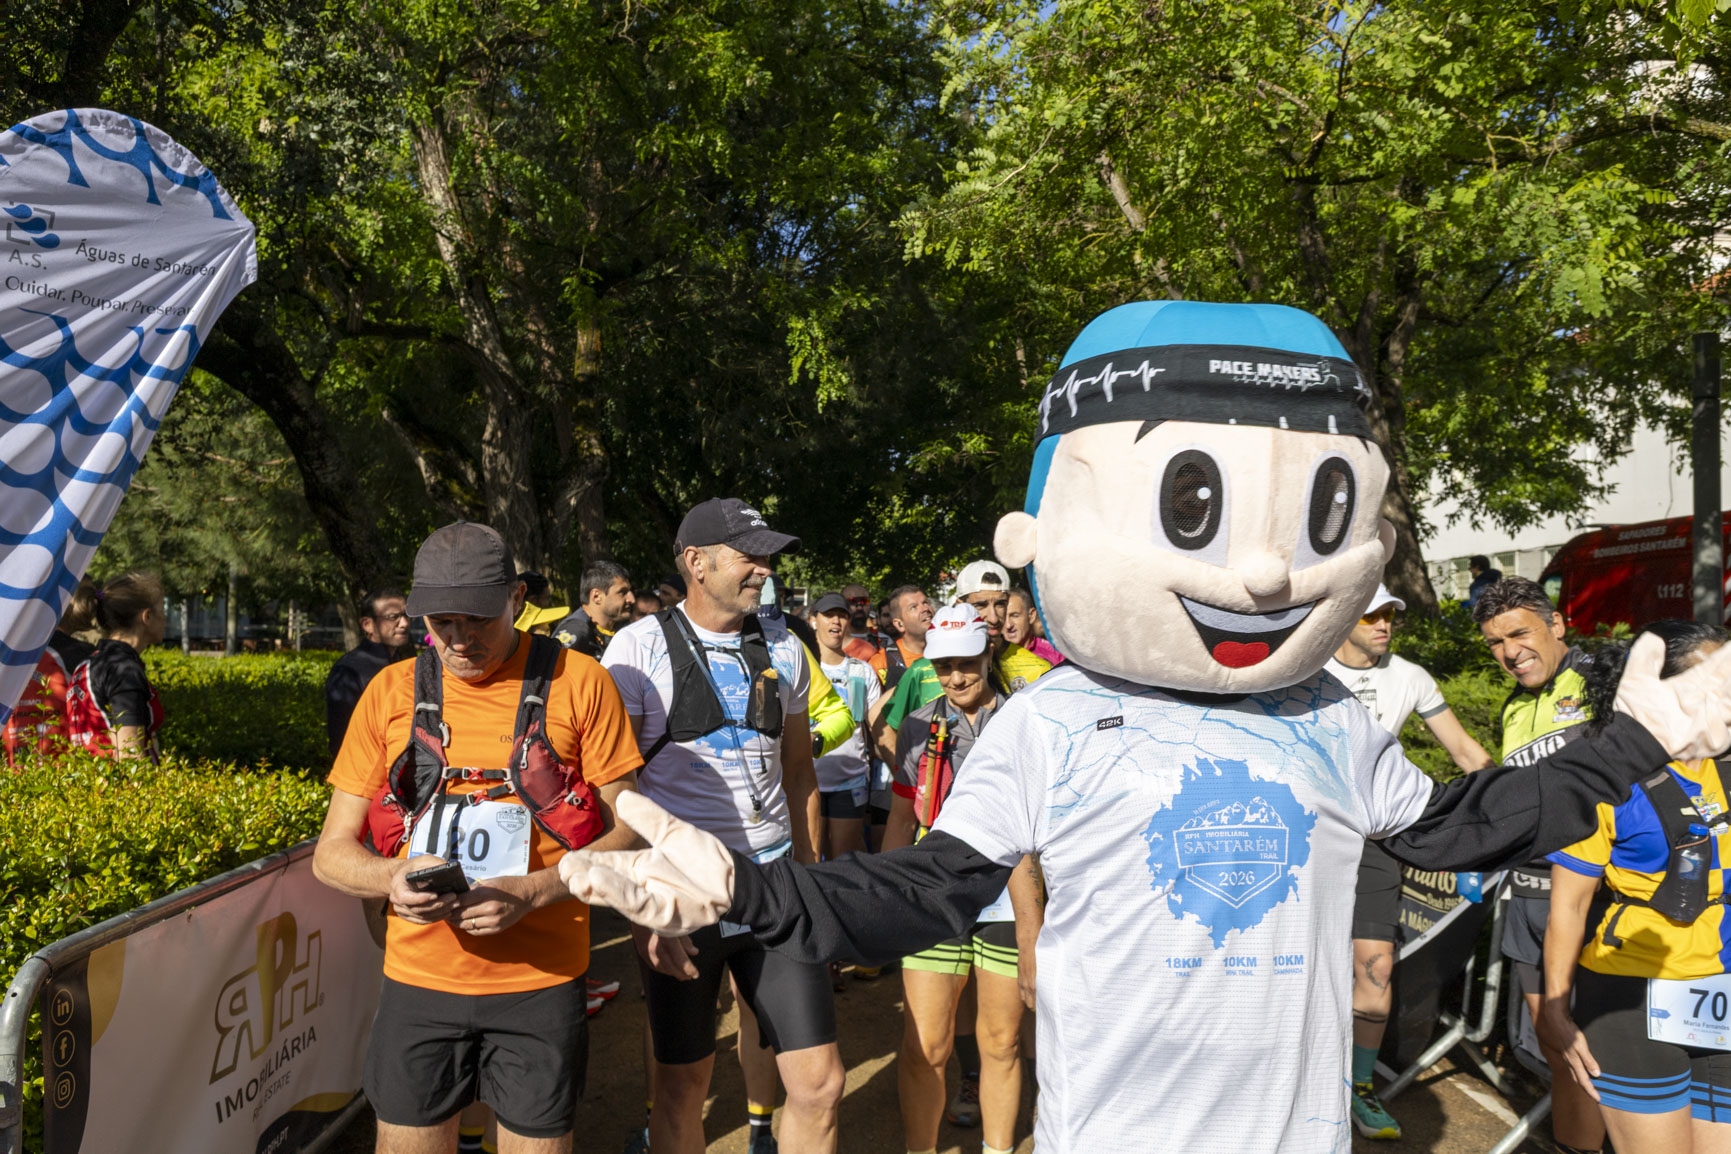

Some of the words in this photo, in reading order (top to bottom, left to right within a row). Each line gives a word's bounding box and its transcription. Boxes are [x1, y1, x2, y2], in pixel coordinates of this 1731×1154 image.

[8, 248, 47, 270] A.S.
[75, 238, 125, 264] Águas
[131, 253, 150, 269] de
[5, 275, 66, 302] Cuidar.
[71, 289, 128, 312] Poupar.
[1208, 359, 1254, 375] PACE
[1256, 363, 1321, 381] MAKERS
[1617, 525, 1668, 541] SAPADORES
[1593, 544, 1638, 559] BOMBEIROS
[1640, 536, 1687, 552] SANTARÉM
[1662, 583, 1684, 599] 112
[1183, 835, 1279, 855] SANTARÉM
[1260, 852, 1279, 860] TRAIL
[1218, 870, 1256, 887] 2026
[1165, 957, 1203, 969] 18KM
[1223, 956, 1257, 968] 10KM
[1273, 954, 1304, 967] 10KM
[1238, 969, 1254, 977] TRAIL
